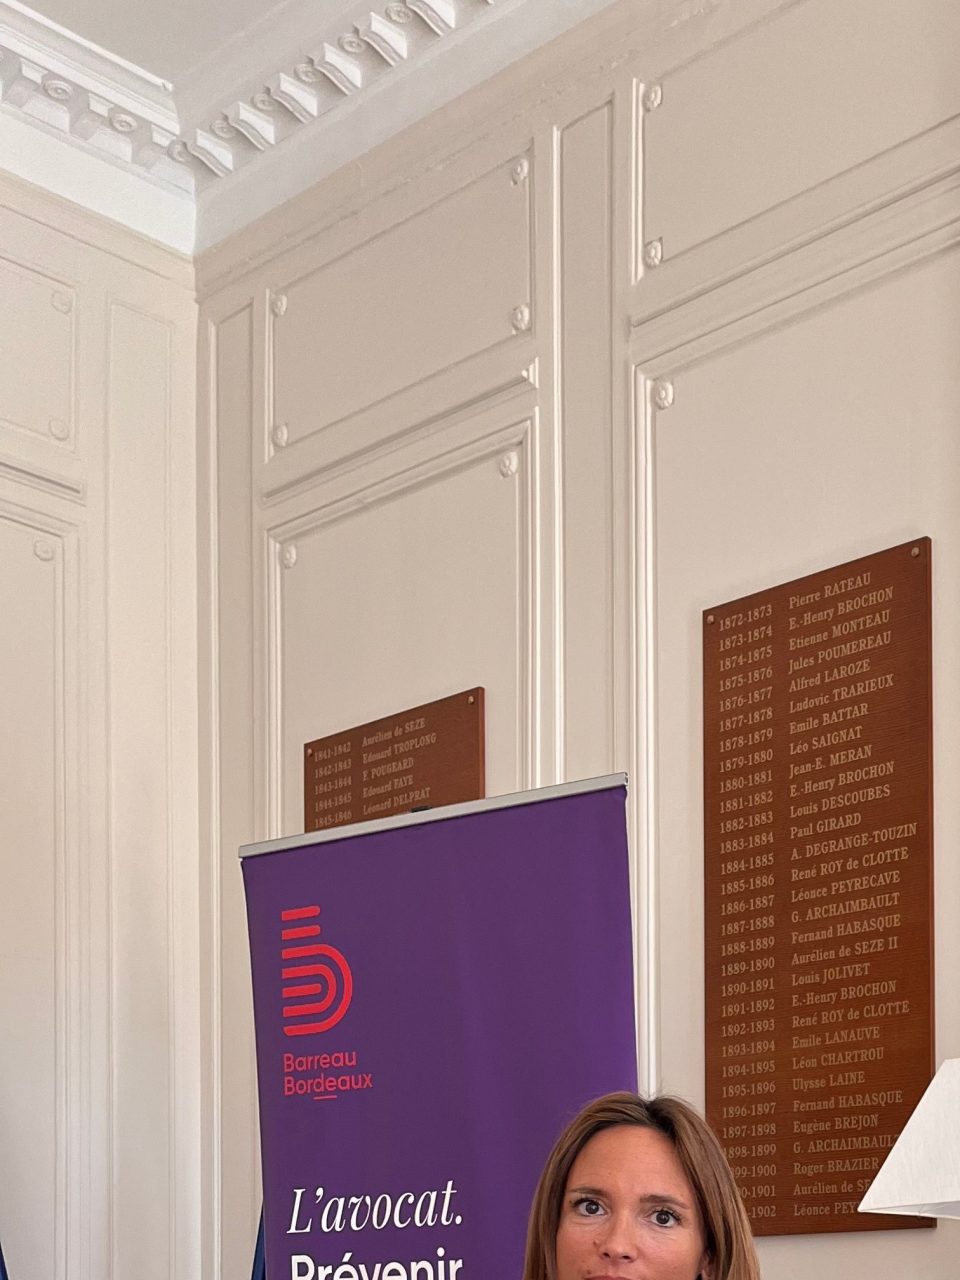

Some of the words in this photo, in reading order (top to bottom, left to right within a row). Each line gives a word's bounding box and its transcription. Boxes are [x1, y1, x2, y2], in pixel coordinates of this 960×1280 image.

[720, 604, 772, 632] 1872-1873
[789, 591, 820, 609] Pierre
[825, 573, 871, 598] RATEAU
[720, 625, 772, 651] 1873-1874
[838, 587, 893, 615] BROCHON
[720, 645, 772, 672] 1874-1875
[789, 631, 828, 651] Etienne
[832, 610, 890, 638] MONTEAU
[720, 667, 772, 692] 1875-1876
[789, 653, 814, 674] Jules
[818, 631, 892, 663] POUMEREAU
[720, 687, 772, 712] 1876-1877
[789, 673, 820, 693] Alfred
[825, 659, 870, 683] LAROZE
[720, 707, 773, 732] 1877-1878
[790, 693, 829, 713] Ludovic
[833, 674, 894, 701] TRARIEUX
[720, 728, 773, 752] 1878-1879
[790, 713, 818, 734] Emile
[823, 703, 869, 725] BATTAR
[720, 749, 773, 773] 1879-1880
[790, 741, 808, 755] Léo
[812, 726, 862, 749] SAIGNAT
[720, 770, 772, 793] 1880-1881
[830, 745, 872, 766] MERAN
[720, 791, 773, 814] 1881-1882
[838, 761, 894, 786] BROCHON
[720, 812, 773, 833] 1882-1883
[790, 802, 818, 818] Louis
[822, 784, 890, 811] DESCOUBES
[720, 832, 774, 854] 1883-1884
[791, 824, 813, 839] Paul
[817, 813, 861, 833] GIRARD
[720, 854, 774, 875] 1884-1885
[791, 848, 802, 860] A.
[806, 822, 917, 857] DEGRANGE-TOUZIN
[721, 875, 774, 895] 1885-1886
[791, 866, 817, 882] René
[821, 859, 843, 876] ROY
[847, 855, 859, 870] de
[863, 847, 909, 867] CLOTTE
[721, 895, 775, 916] 1886-1887
[792, 886, 828, 902] Léonce
[831, 871, 900, 895] PEYRECAVE
[721, 916, 775, 936] 1887-1888
[792, 911, 802, 923] G.
[806, 892, 900, 921] ARCHAIMBAULT
[721, 937, 775, 957] 1888-1889
[792, 927, 833, 944] Fernand
[837, 914, 901, 936] HABASQUE
[721, 957, 775, 976] 1889-1890
[792, 949, 835, 965] Aurélien
[839, 943, 851, 957] de
[855, 938, 884, 955] SEZE
[888, 936, 898, 949] II
[721, 978, 774, 997] 1890-1891
[792, 972, 820, 986] Louis
[823, 963, 870, 984] JOLIVET
[722, 999, 774, 1018] 1891-1892
[841, 981, 896, 1000] BROCHON
[722, 1019, 775, 1037] 1892-1893
[792, 1013, 817, 1028] René
[822, 1007, 844, 1024] ROY
[848, 1004, 859, 1020] de
[864, 1000, 909, 1018] CLOTTE
[283, 1049, 357, 1073] Barreau
[722, 1040, 775, 1057] 1893-1894
[793, 1033, 821, 1049] Emile
[825, 1027, 880, 1044] LANAUVE
[722, 1061, 775, 1078] 1894-1895
[793, 1056, 817, 1070] Léon
[821, 1047, 884, 1065] CHARTROU
[284, 1072, 372, 1095] Bordeaux
[723, 1082, 776, 1098] 1895-1896
[793, 1076, 825, 1091] Ulysse
[830, 1071, 865, 1087] LAINE
[723, 1102, 776, 1119] 1896-1897
[794, 1096, 834, 1112] Fernand
[839, 1091, 902, 1108] HABASQUE
[723, 1123, 776, 1139] 1897-1898
[794, 1117, 831, 1134] Eugène
[835, 1114, 879, 1129] BREJON
[794, 1161, 823, 1177] Roger
[828, 1157, 879, 1172] BRAZIER
[287, 1179, 463, 1235] L'avocat.
[737, 1184, 776, 1199] 0-1901
[794, 1182, 837, 1195] Aurélien
[841, 1179, 853, 1193] de
[794, 1202, 830, 1217] Léonce
